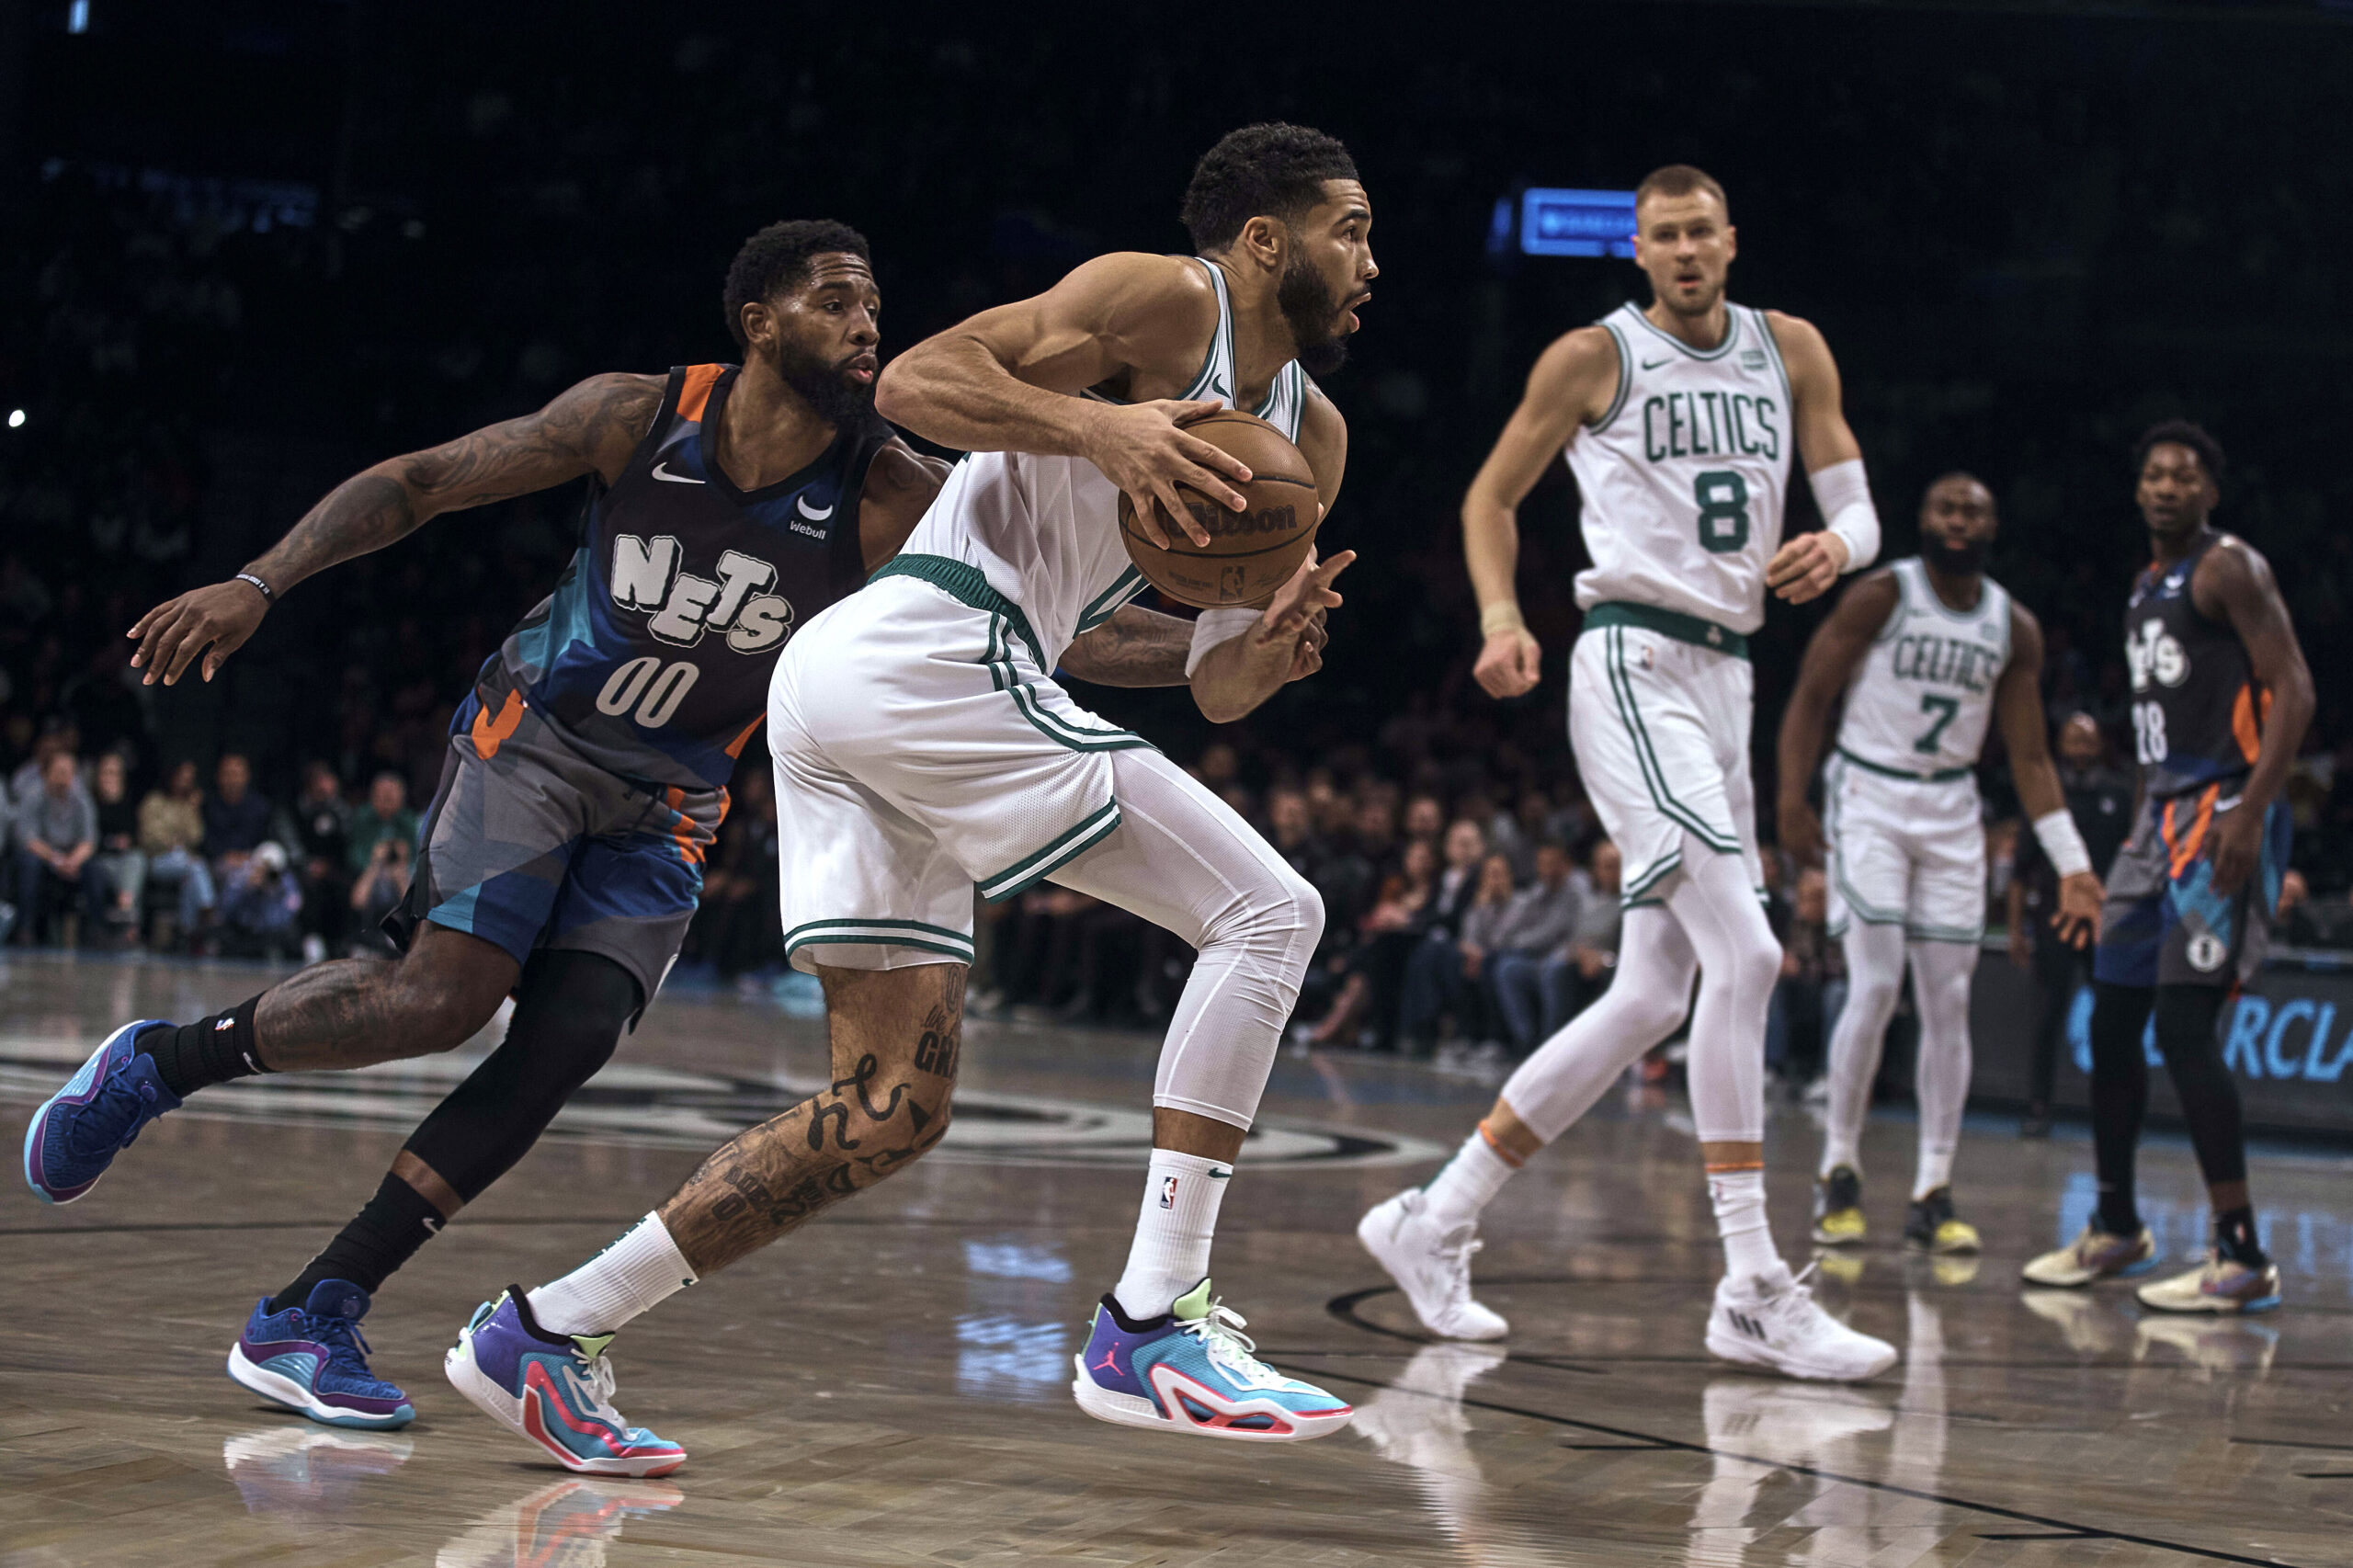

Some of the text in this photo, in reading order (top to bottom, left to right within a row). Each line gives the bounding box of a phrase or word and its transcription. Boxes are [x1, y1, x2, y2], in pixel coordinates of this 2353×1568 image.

[1643, 392, 1779, 462] CELTICS
[790, 520, 826, 540] Webull
[1694, 471, 1749, 554] 8
[597, 656, 700, 729] 00
[1915, 693, 1960, 756] 7
